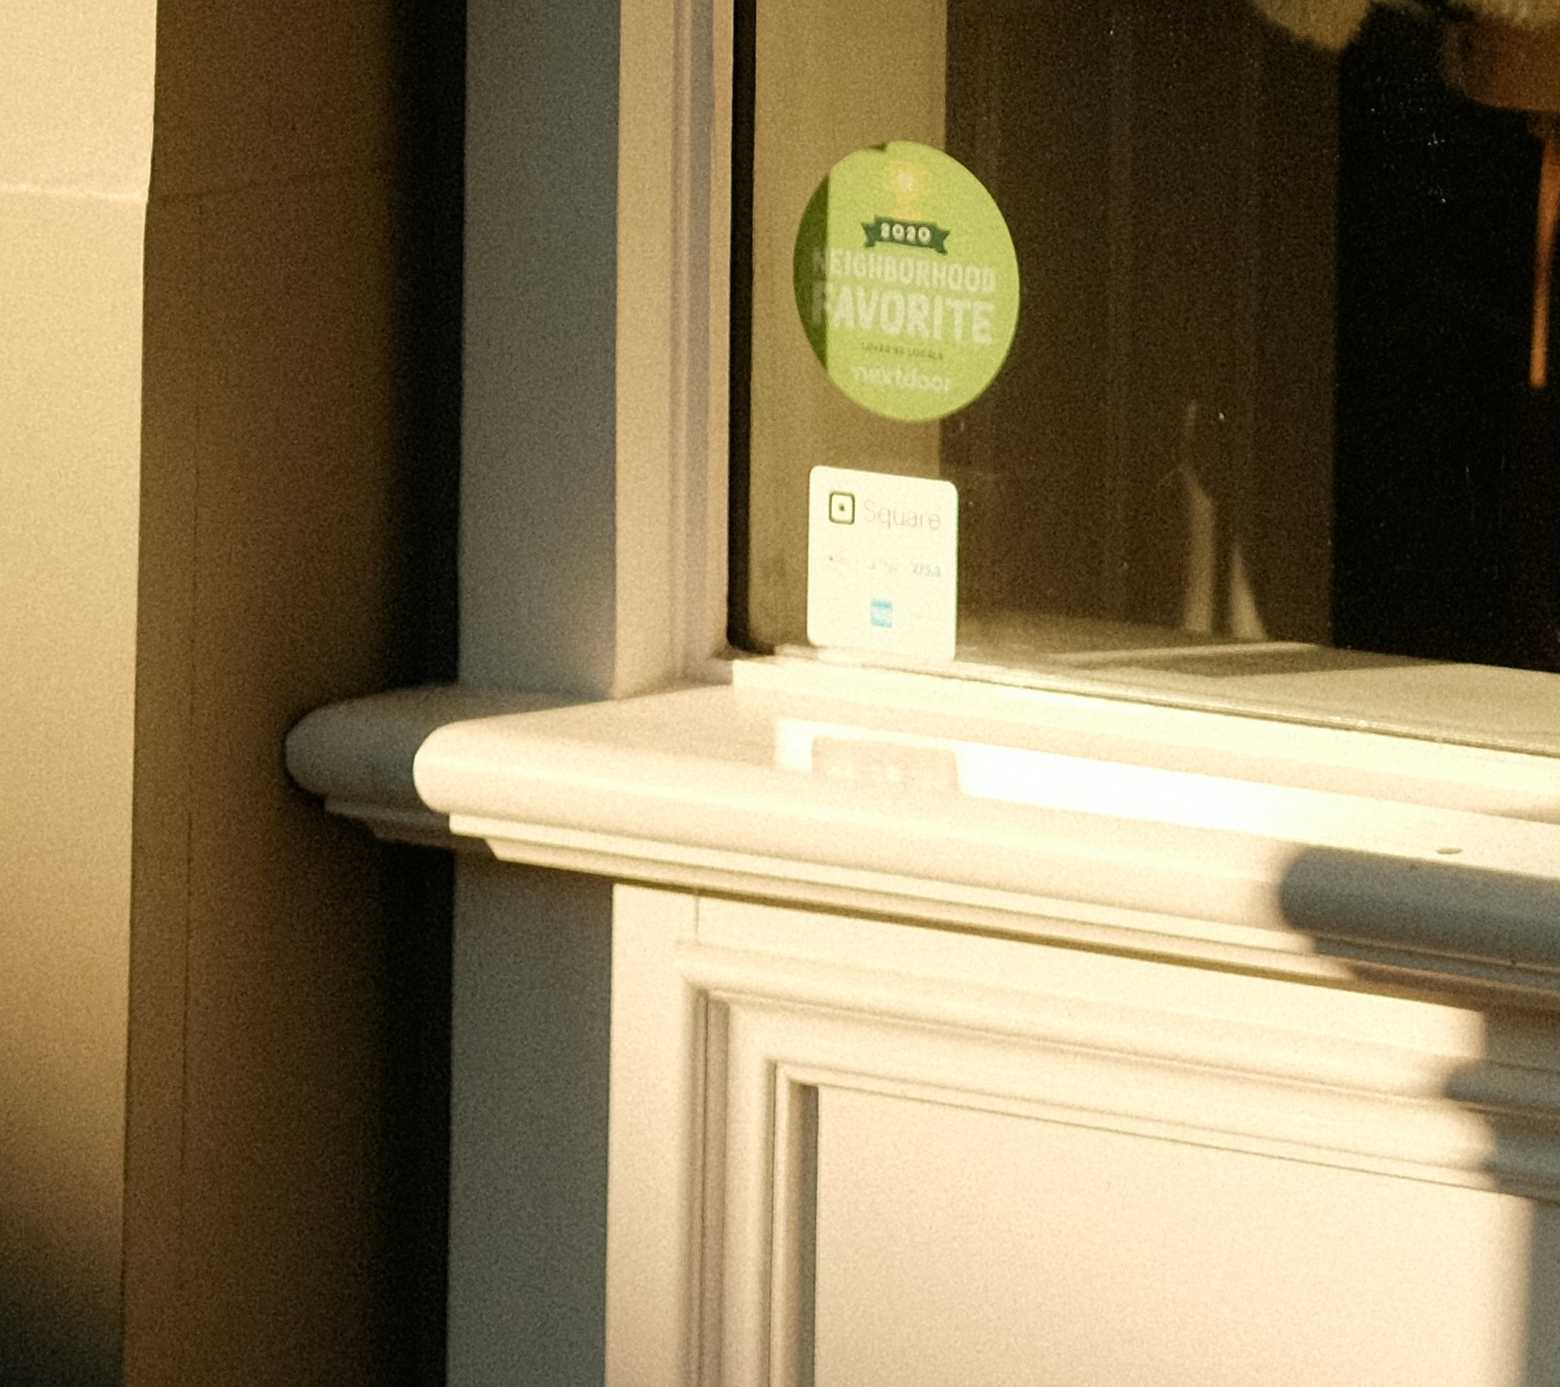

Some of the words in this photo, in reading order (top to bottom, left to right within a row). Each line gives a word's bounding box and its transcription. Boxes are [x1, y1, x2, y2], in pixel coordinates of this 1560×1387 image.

[880, 221, 932, 245] 2020
[813, 247, 997, 294] NEIGHBORHOOD
[811, 282, 996, 346] FAVORITE
[863, 498, 942, 531] Square
